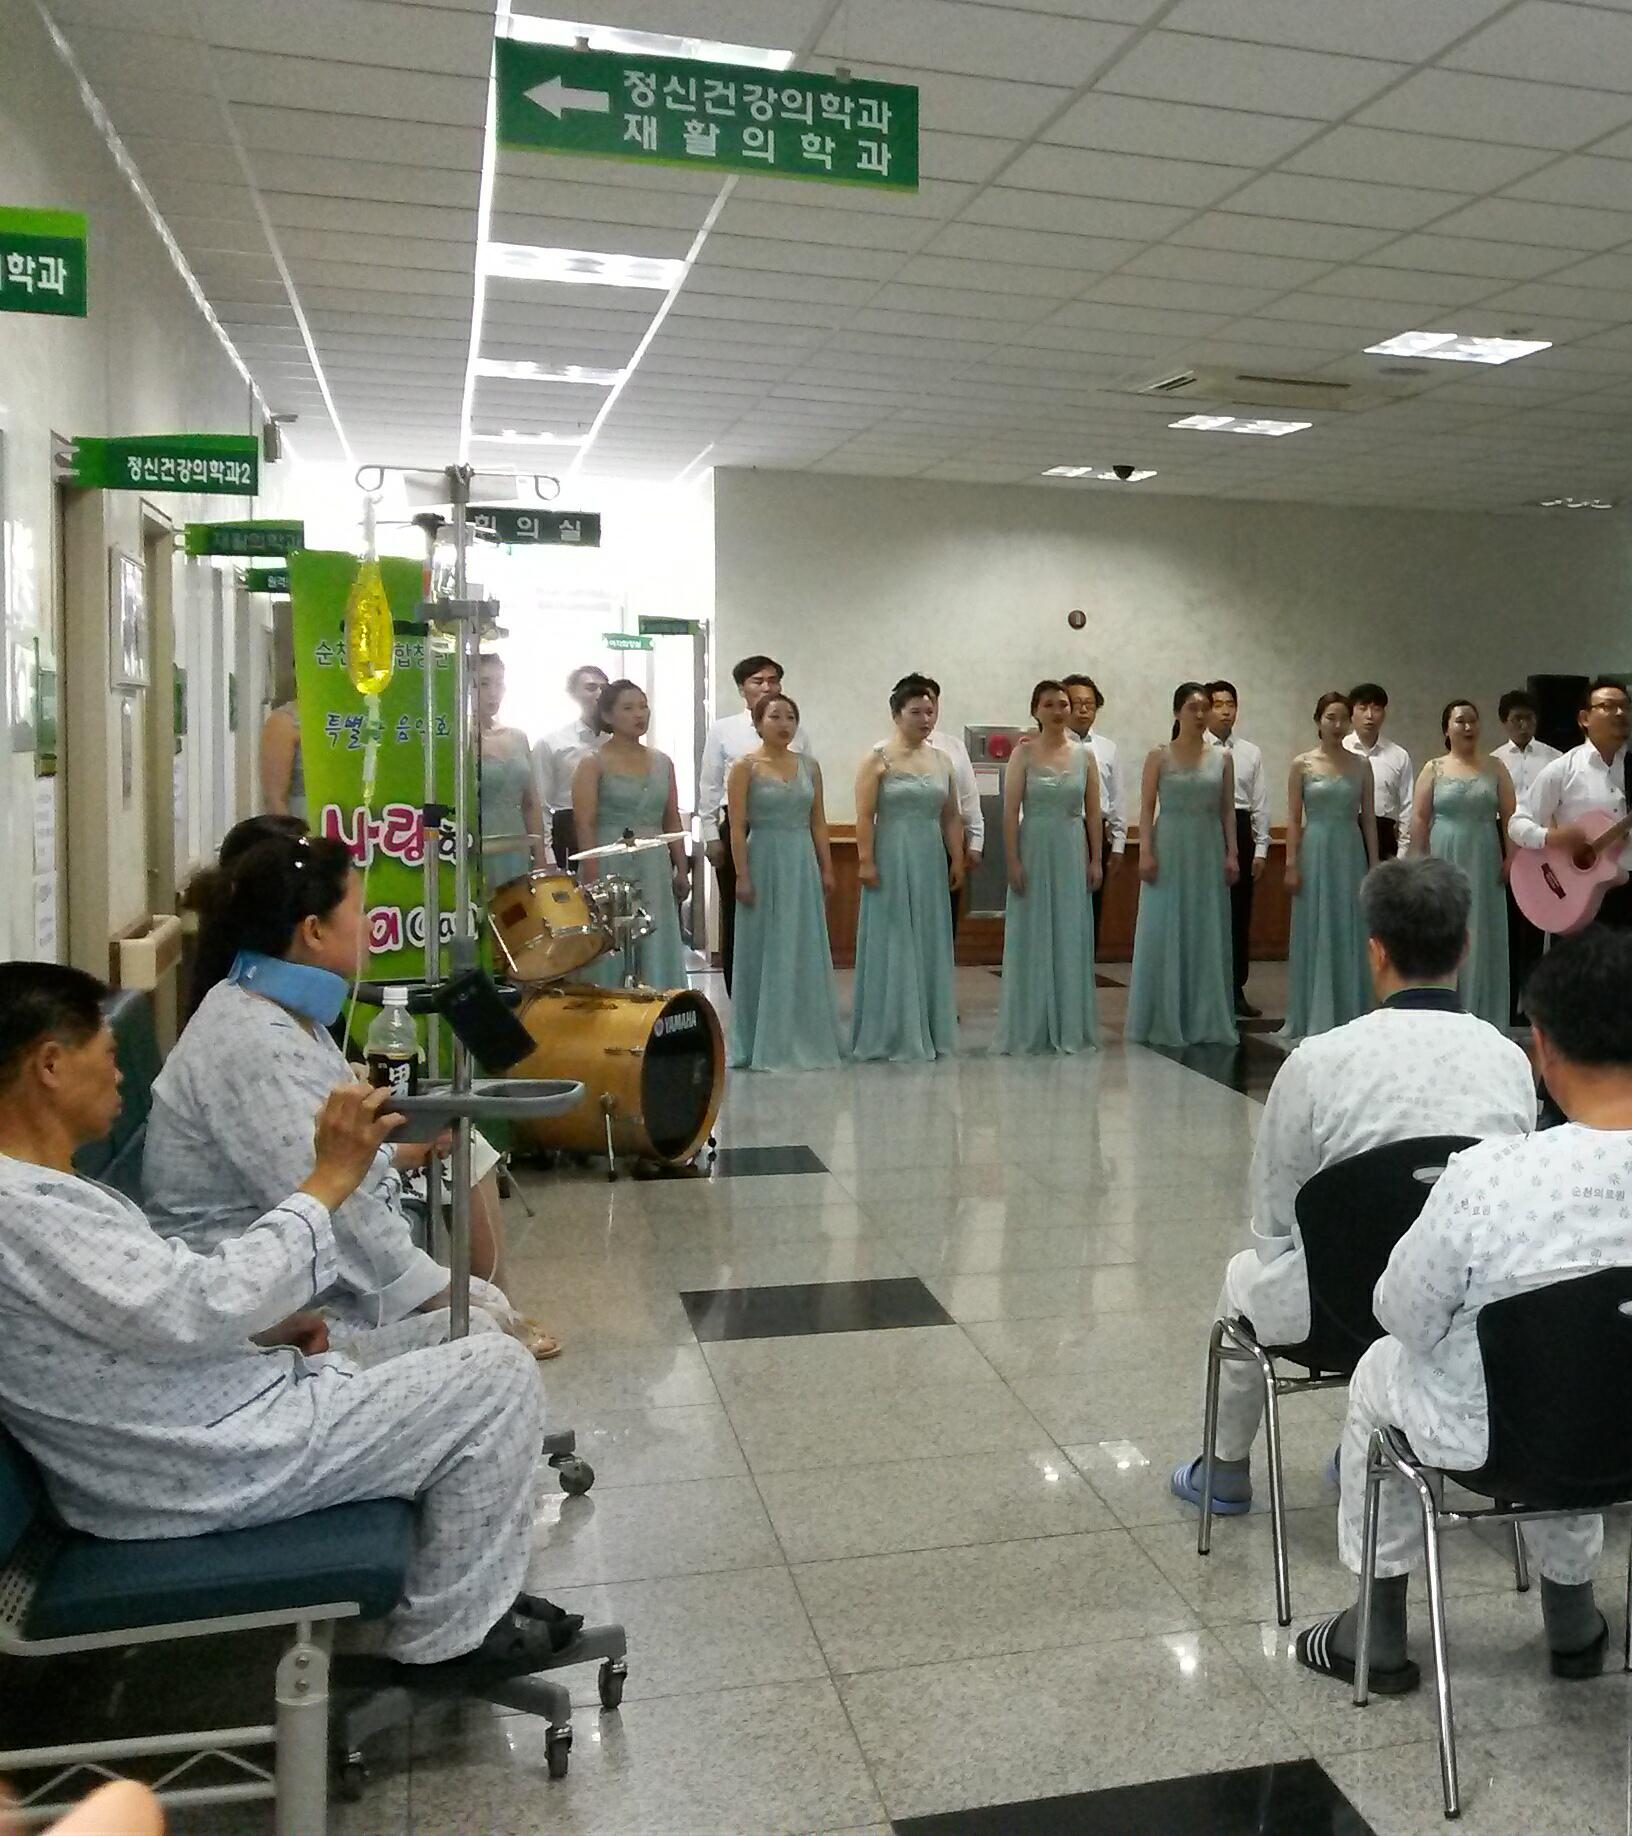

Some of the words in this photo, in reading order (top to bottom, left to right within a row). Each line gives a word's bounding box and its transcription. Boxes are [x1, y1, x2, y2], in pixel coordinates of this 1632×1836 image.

[623, 69, 892, 135] 정신건강의학과
[0, 252, 67, 295] 학과
[127, 455, 251, 486] 정신건강의학과2
[665, 1010, 697, 1034] YAMAHA
